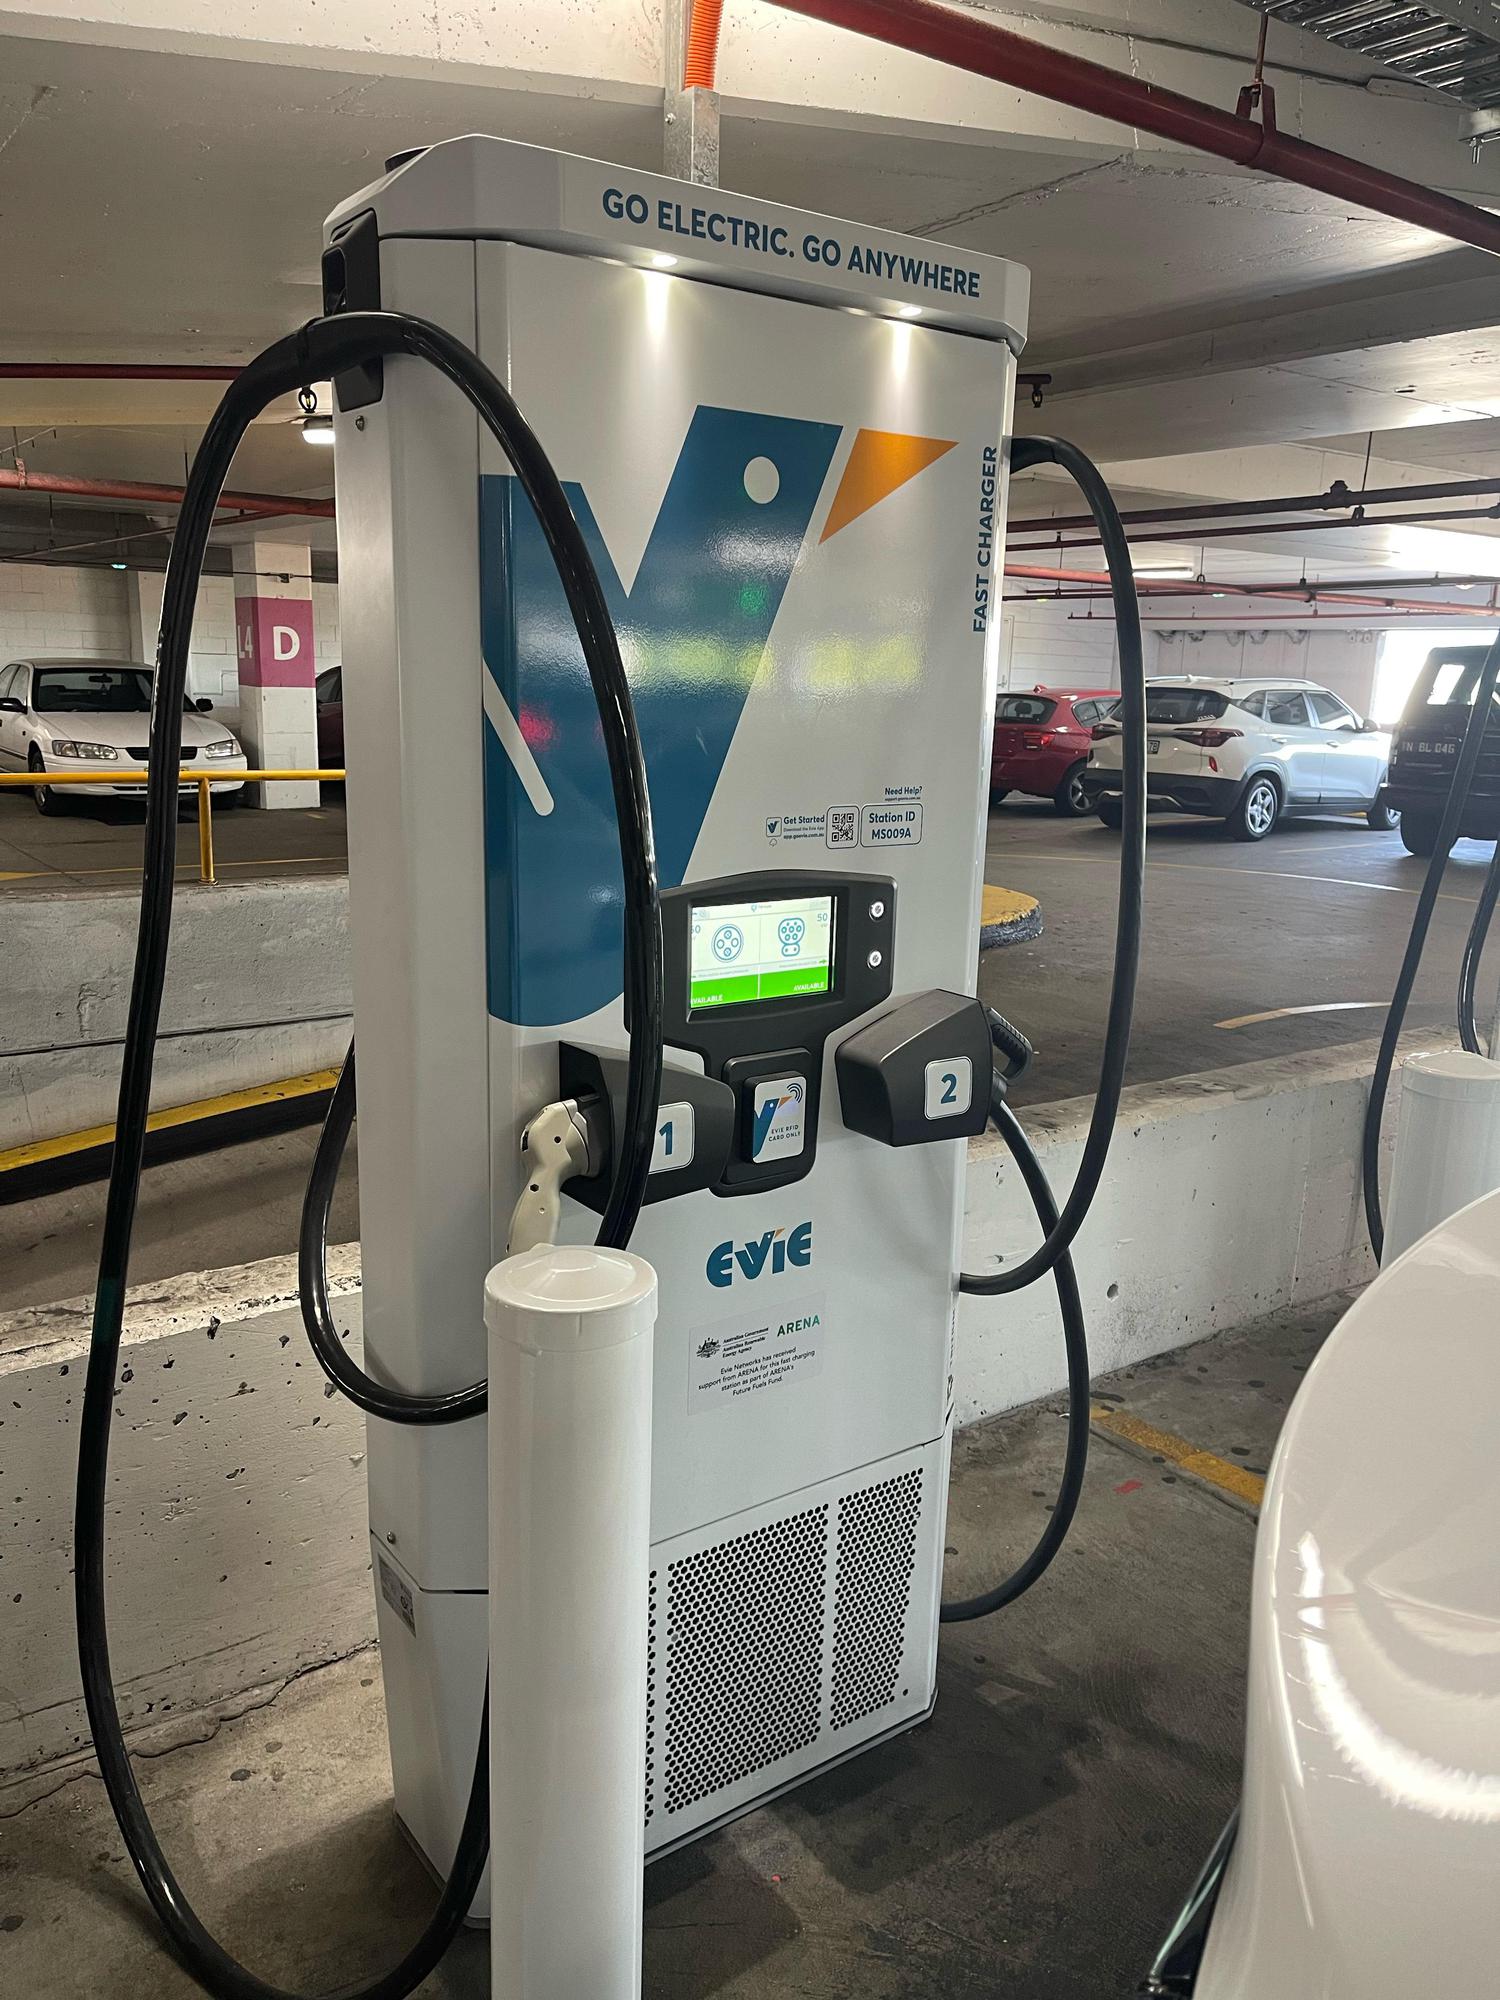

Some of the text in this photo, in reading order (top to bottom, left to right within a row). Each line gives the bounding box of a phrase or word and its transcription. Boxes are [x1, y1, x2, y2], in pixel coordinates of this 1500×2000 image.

[602, 188, 981, 298] GO ELECTRIC. GO ANYWHERE
[973, 446, 997, 632] FAST CHARGER
[237, 625, 253, 659] L4
[273, 625, 301, 661] D
[885, 785, 923, 796] Need Help?
[783, 814, 825, 824] Get Started
[868, 811, 916, 824] Station ID
[871, 827, 912, 840] MS009A
[816, 913, 828, 922] 50
[793, 981, 825, 992] AVAILABLE
[940, 1073, 958, 1105] 2
[659, 1121, 673, 1156] 1
[777, 1314, 820, 1337] ARENA
[698, 1350, 816, 1391] support from ARENA for this fast charging
[720, 1346, 797, 1375] Evie Networks has received
[721, 1381, 741, 1392] station
[749, 1374, 762, 1384] part
[762, 1371, 769, 1379] of
[769, 1364, 794, 1377] ARENA's
[732, 1375, 783, 1396] Future Fuels Fund.
